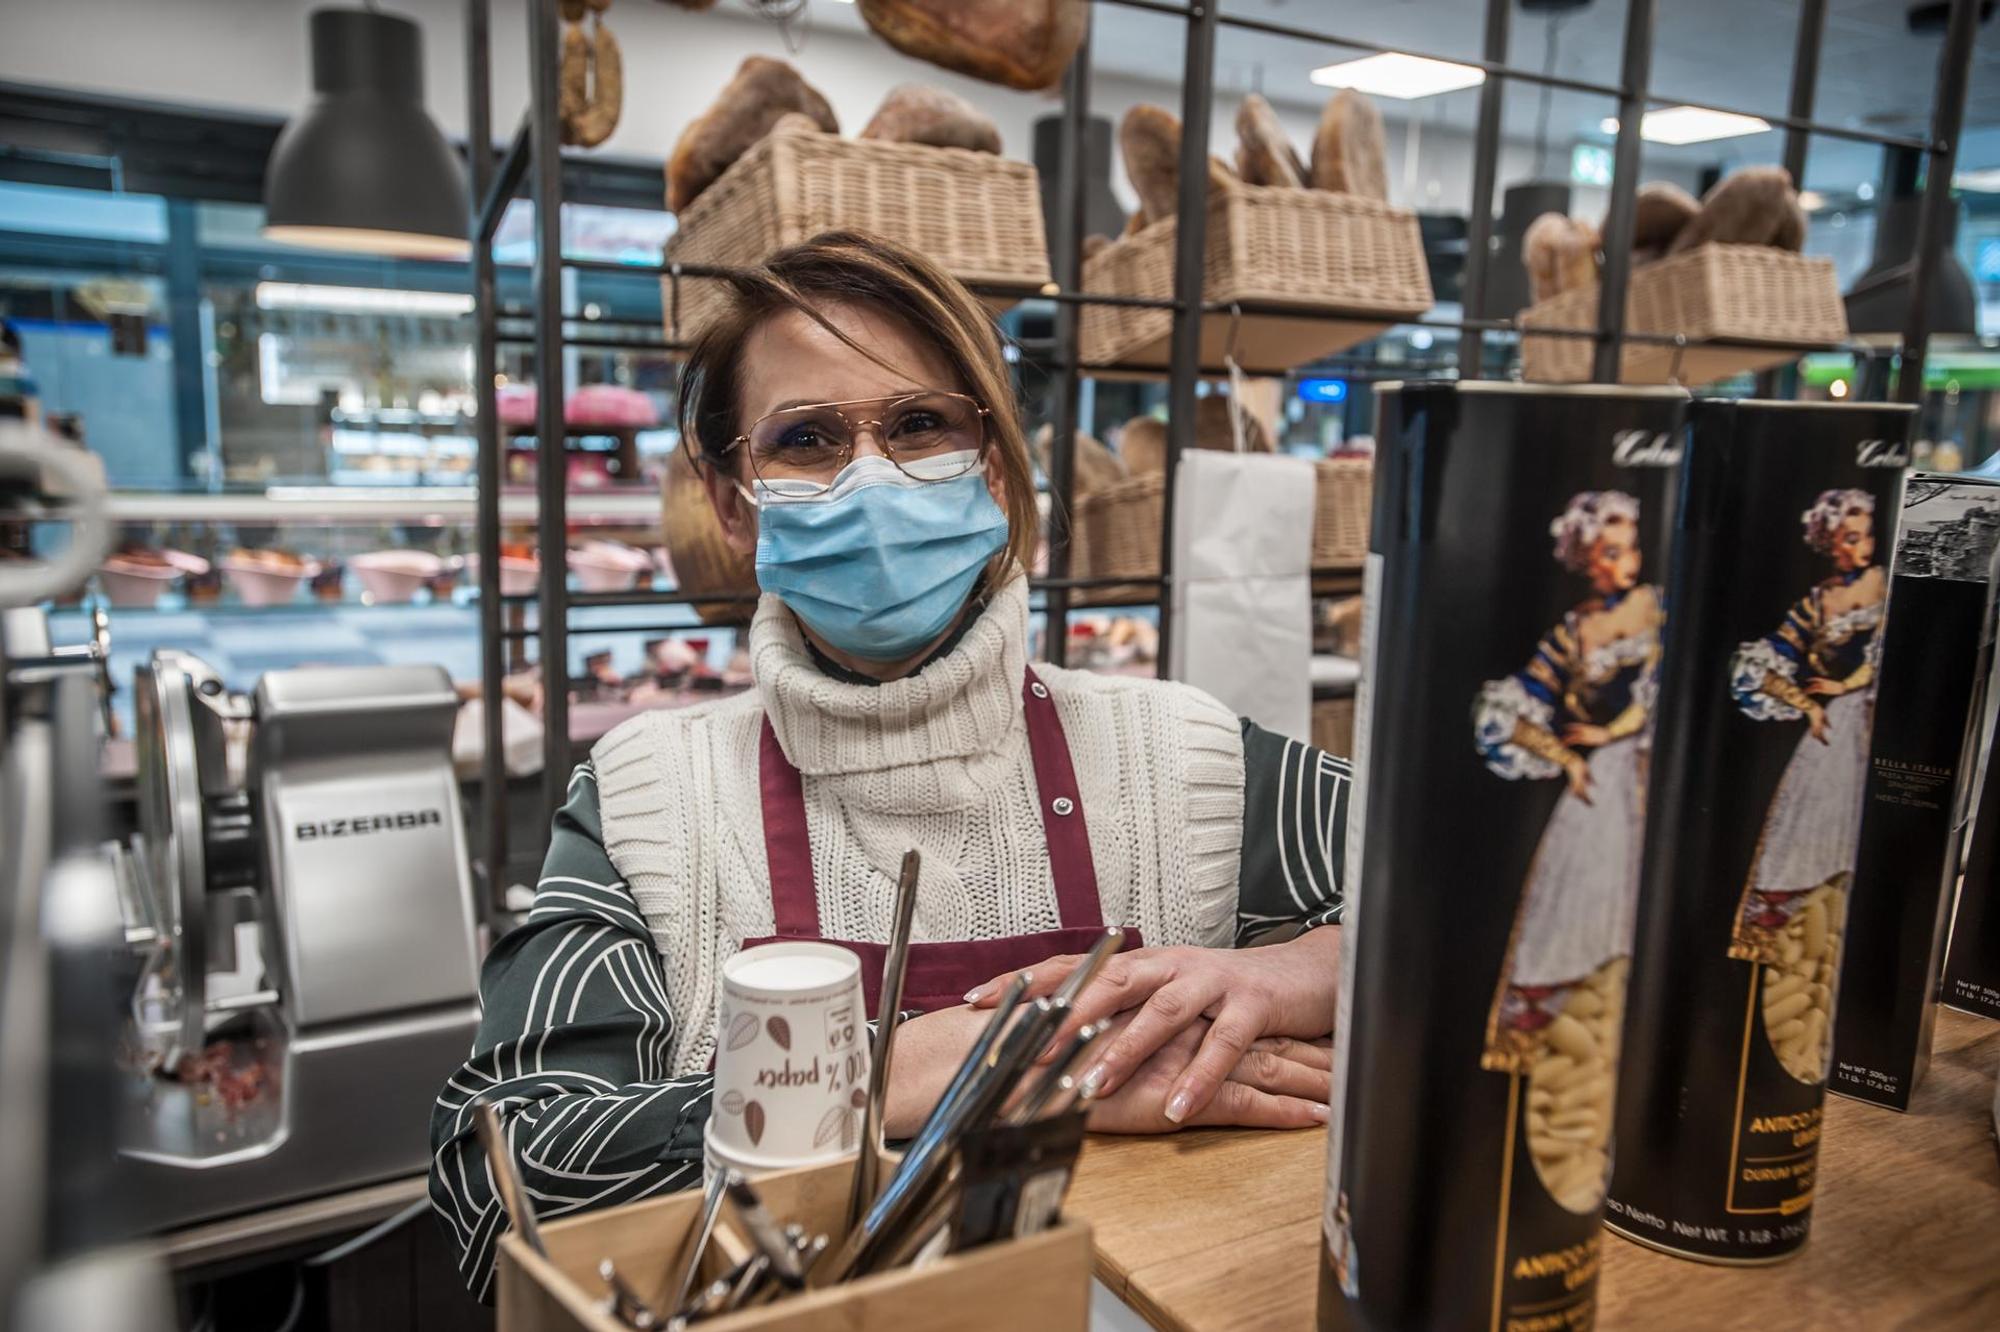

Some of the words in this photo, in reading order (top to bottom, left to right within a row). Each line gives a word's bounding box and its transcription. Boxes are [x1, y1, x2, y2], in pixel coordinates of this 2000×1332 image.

[1875, 757, 1908, 769] BELLA
[1912, 764, 1952, 776] ITALIA
[296, 809, 440, 841] BIZERBA
[1957, 979, 1969, 988] Net
[754, 1056, 820, 1089] paper
[1840, 1061, 1853, 1072] Net
[1750, 1111, 1811, 1133] ANTICO
[1626, 1204, 1667, 1230] Netto
[1673, 1220, 1701, 1238] Net
